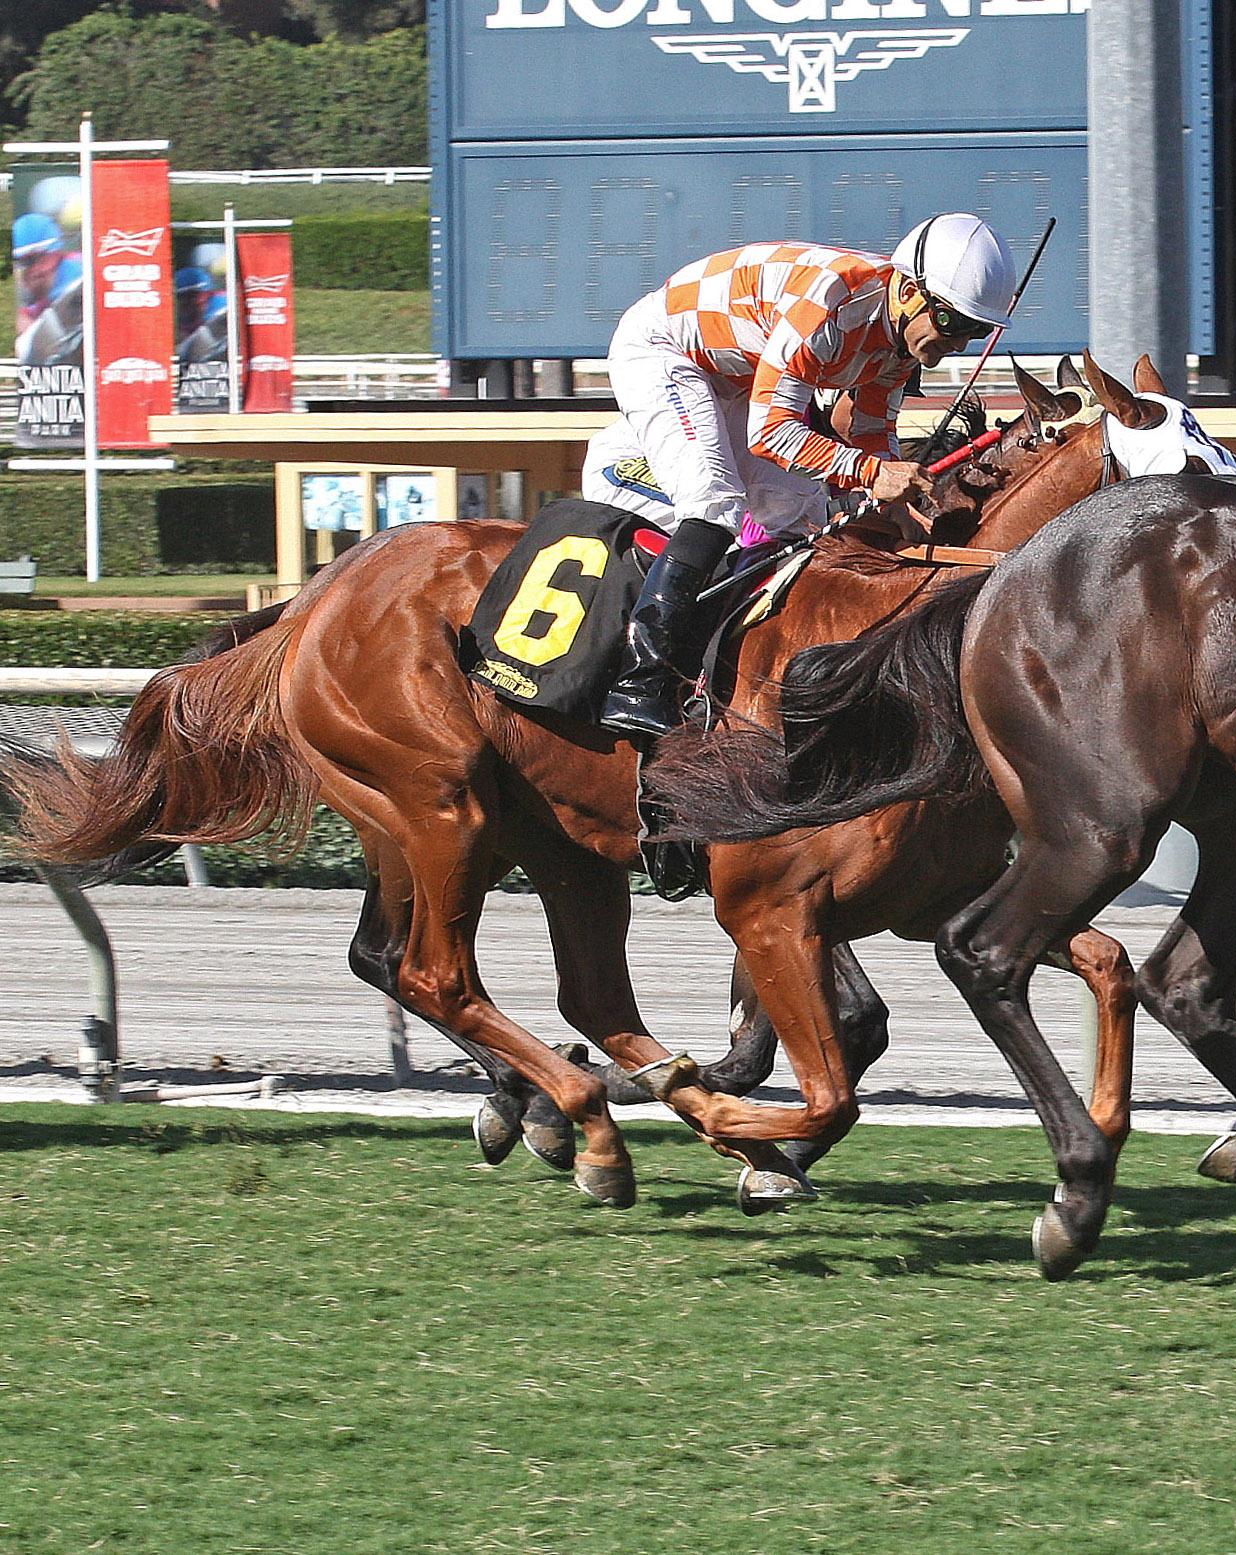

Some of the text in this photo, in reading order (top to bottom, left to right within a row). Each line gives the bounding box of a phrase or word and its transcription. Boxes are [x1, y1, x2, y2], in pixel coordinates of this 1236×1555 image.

[17, 365, 85, 394] SANTA
[18, 395, 85, 424] ANITA
[665, 383, 697, 441] Equiwin
[492, 535, 610, 668] 6
